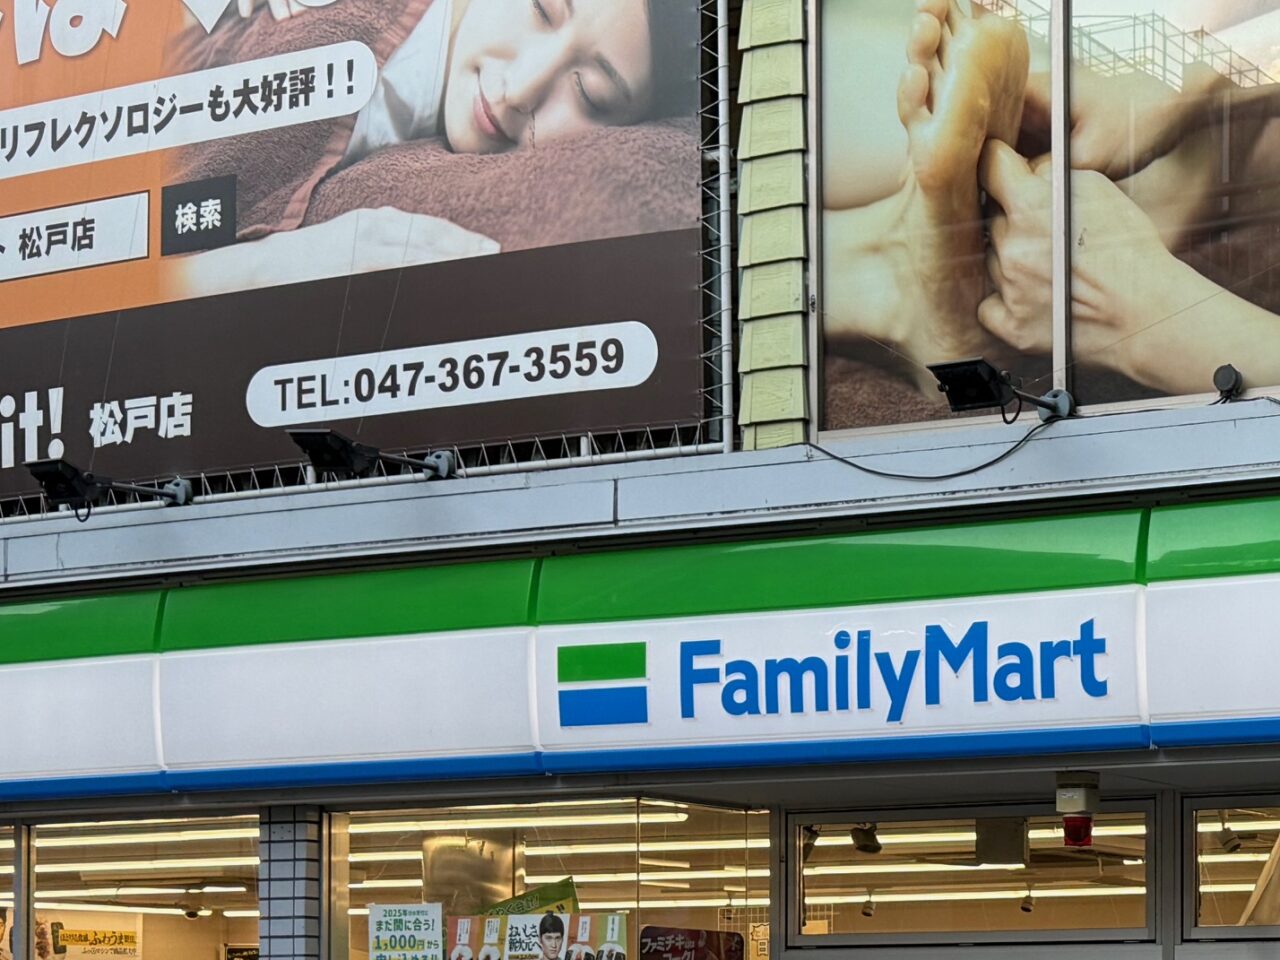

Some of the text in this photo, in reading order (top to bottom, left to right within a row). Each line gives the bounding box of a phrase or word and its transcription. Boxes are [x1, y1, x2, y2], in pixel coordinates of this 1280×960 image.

[174, 198, 222, 235] 検索
[18, 218, 95, 261] 松戸店
[273, 337, 625, 412] TEL:047-367-3559
[89, 391, 193, 447] 松戸店
[679, 619, 1108, 723] FamilyMart
[374, 934, 440, 951] 1,000円から
[375, 918, 435, 932] まだ間に合う!
